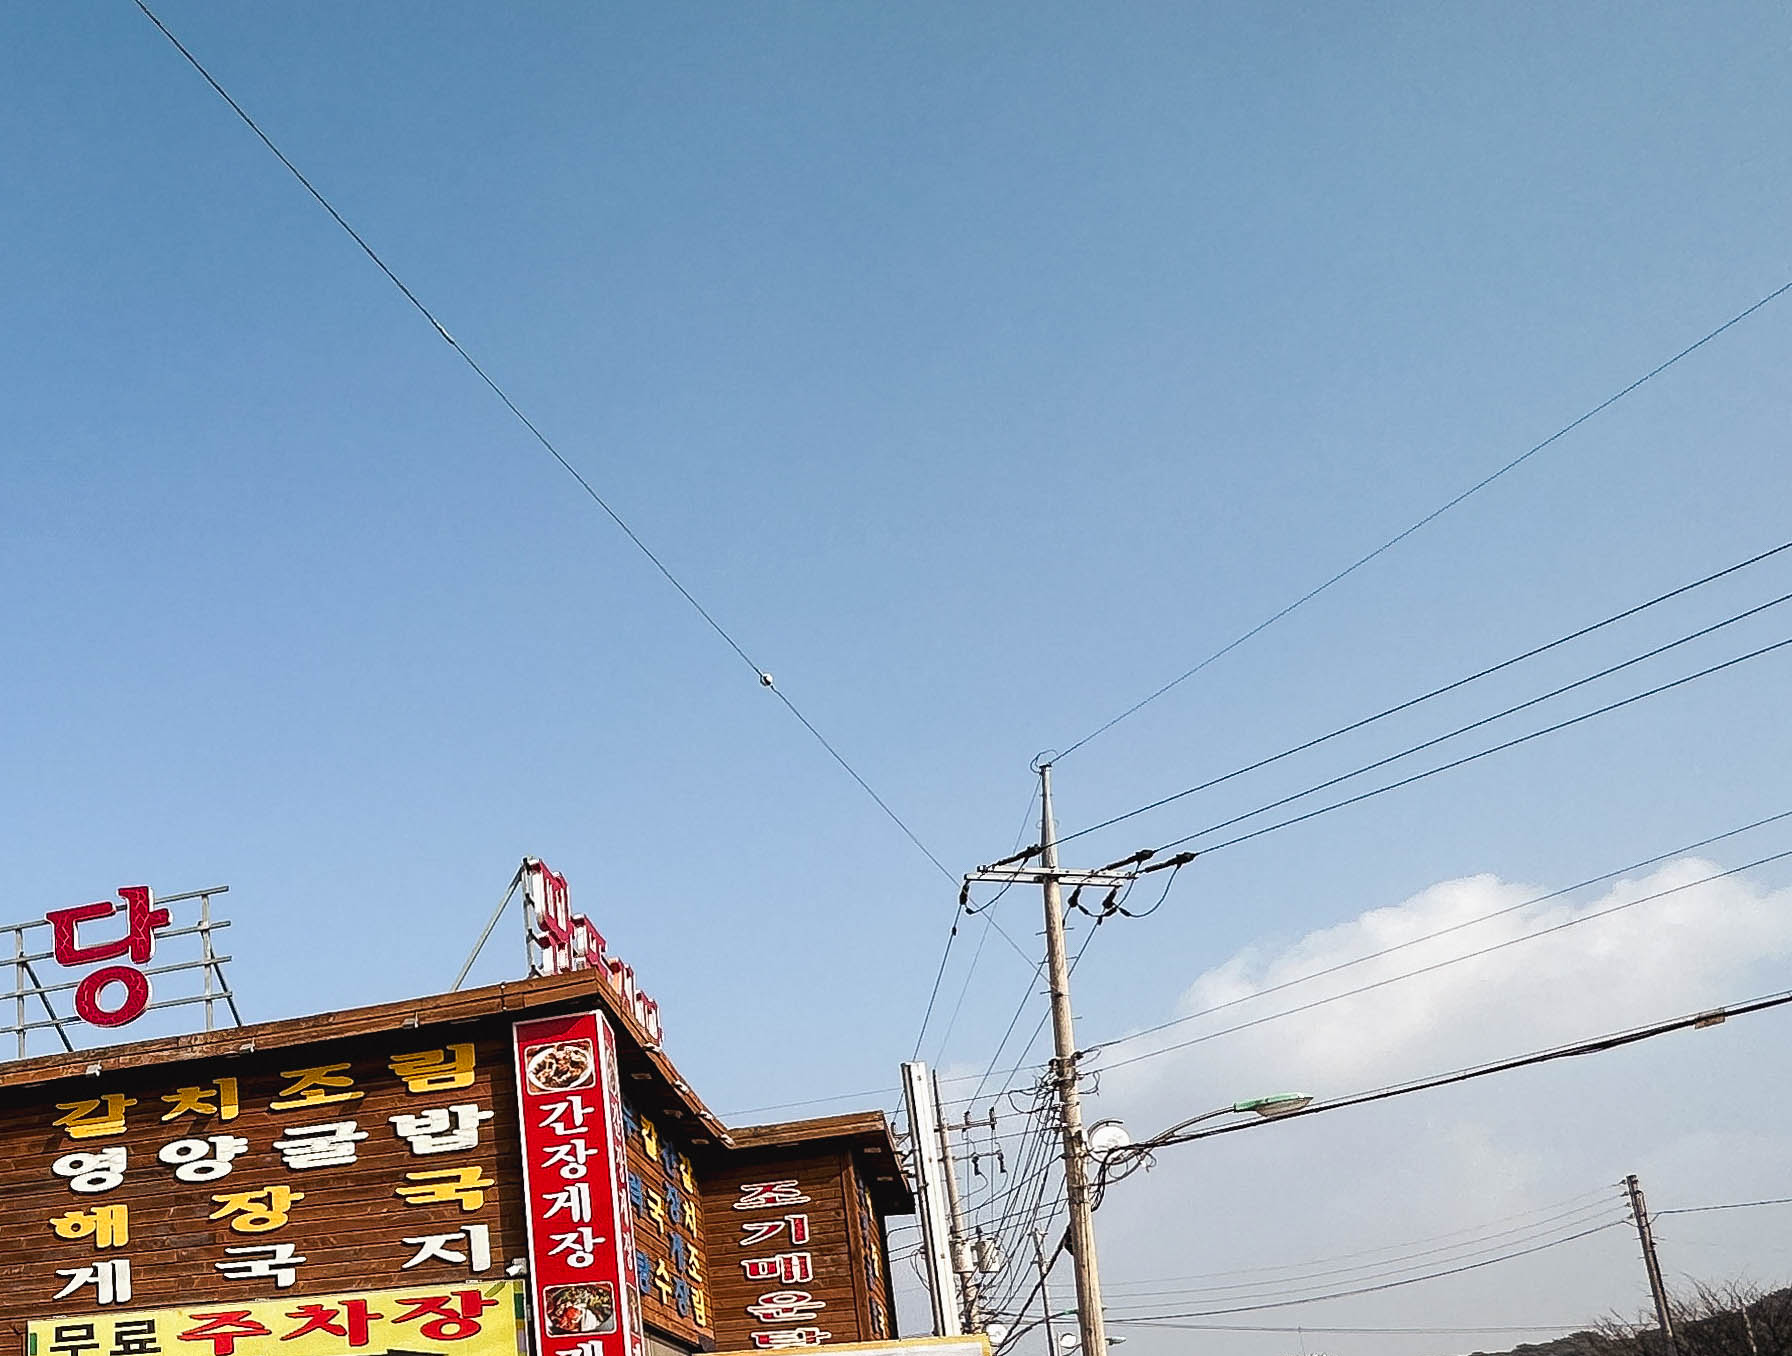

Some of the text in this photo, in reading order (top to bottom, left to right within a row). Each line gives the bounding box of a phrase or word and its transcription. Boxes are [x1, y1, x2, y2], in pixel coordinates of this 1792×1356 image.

[54, 1042, 476, 1139] 갈치조림
[52, 1104, 494, 1193] 영양굴밥
[538, 1096, 605, 1269] 간장게장
[177, 1290, 500, 1356] 주차장
